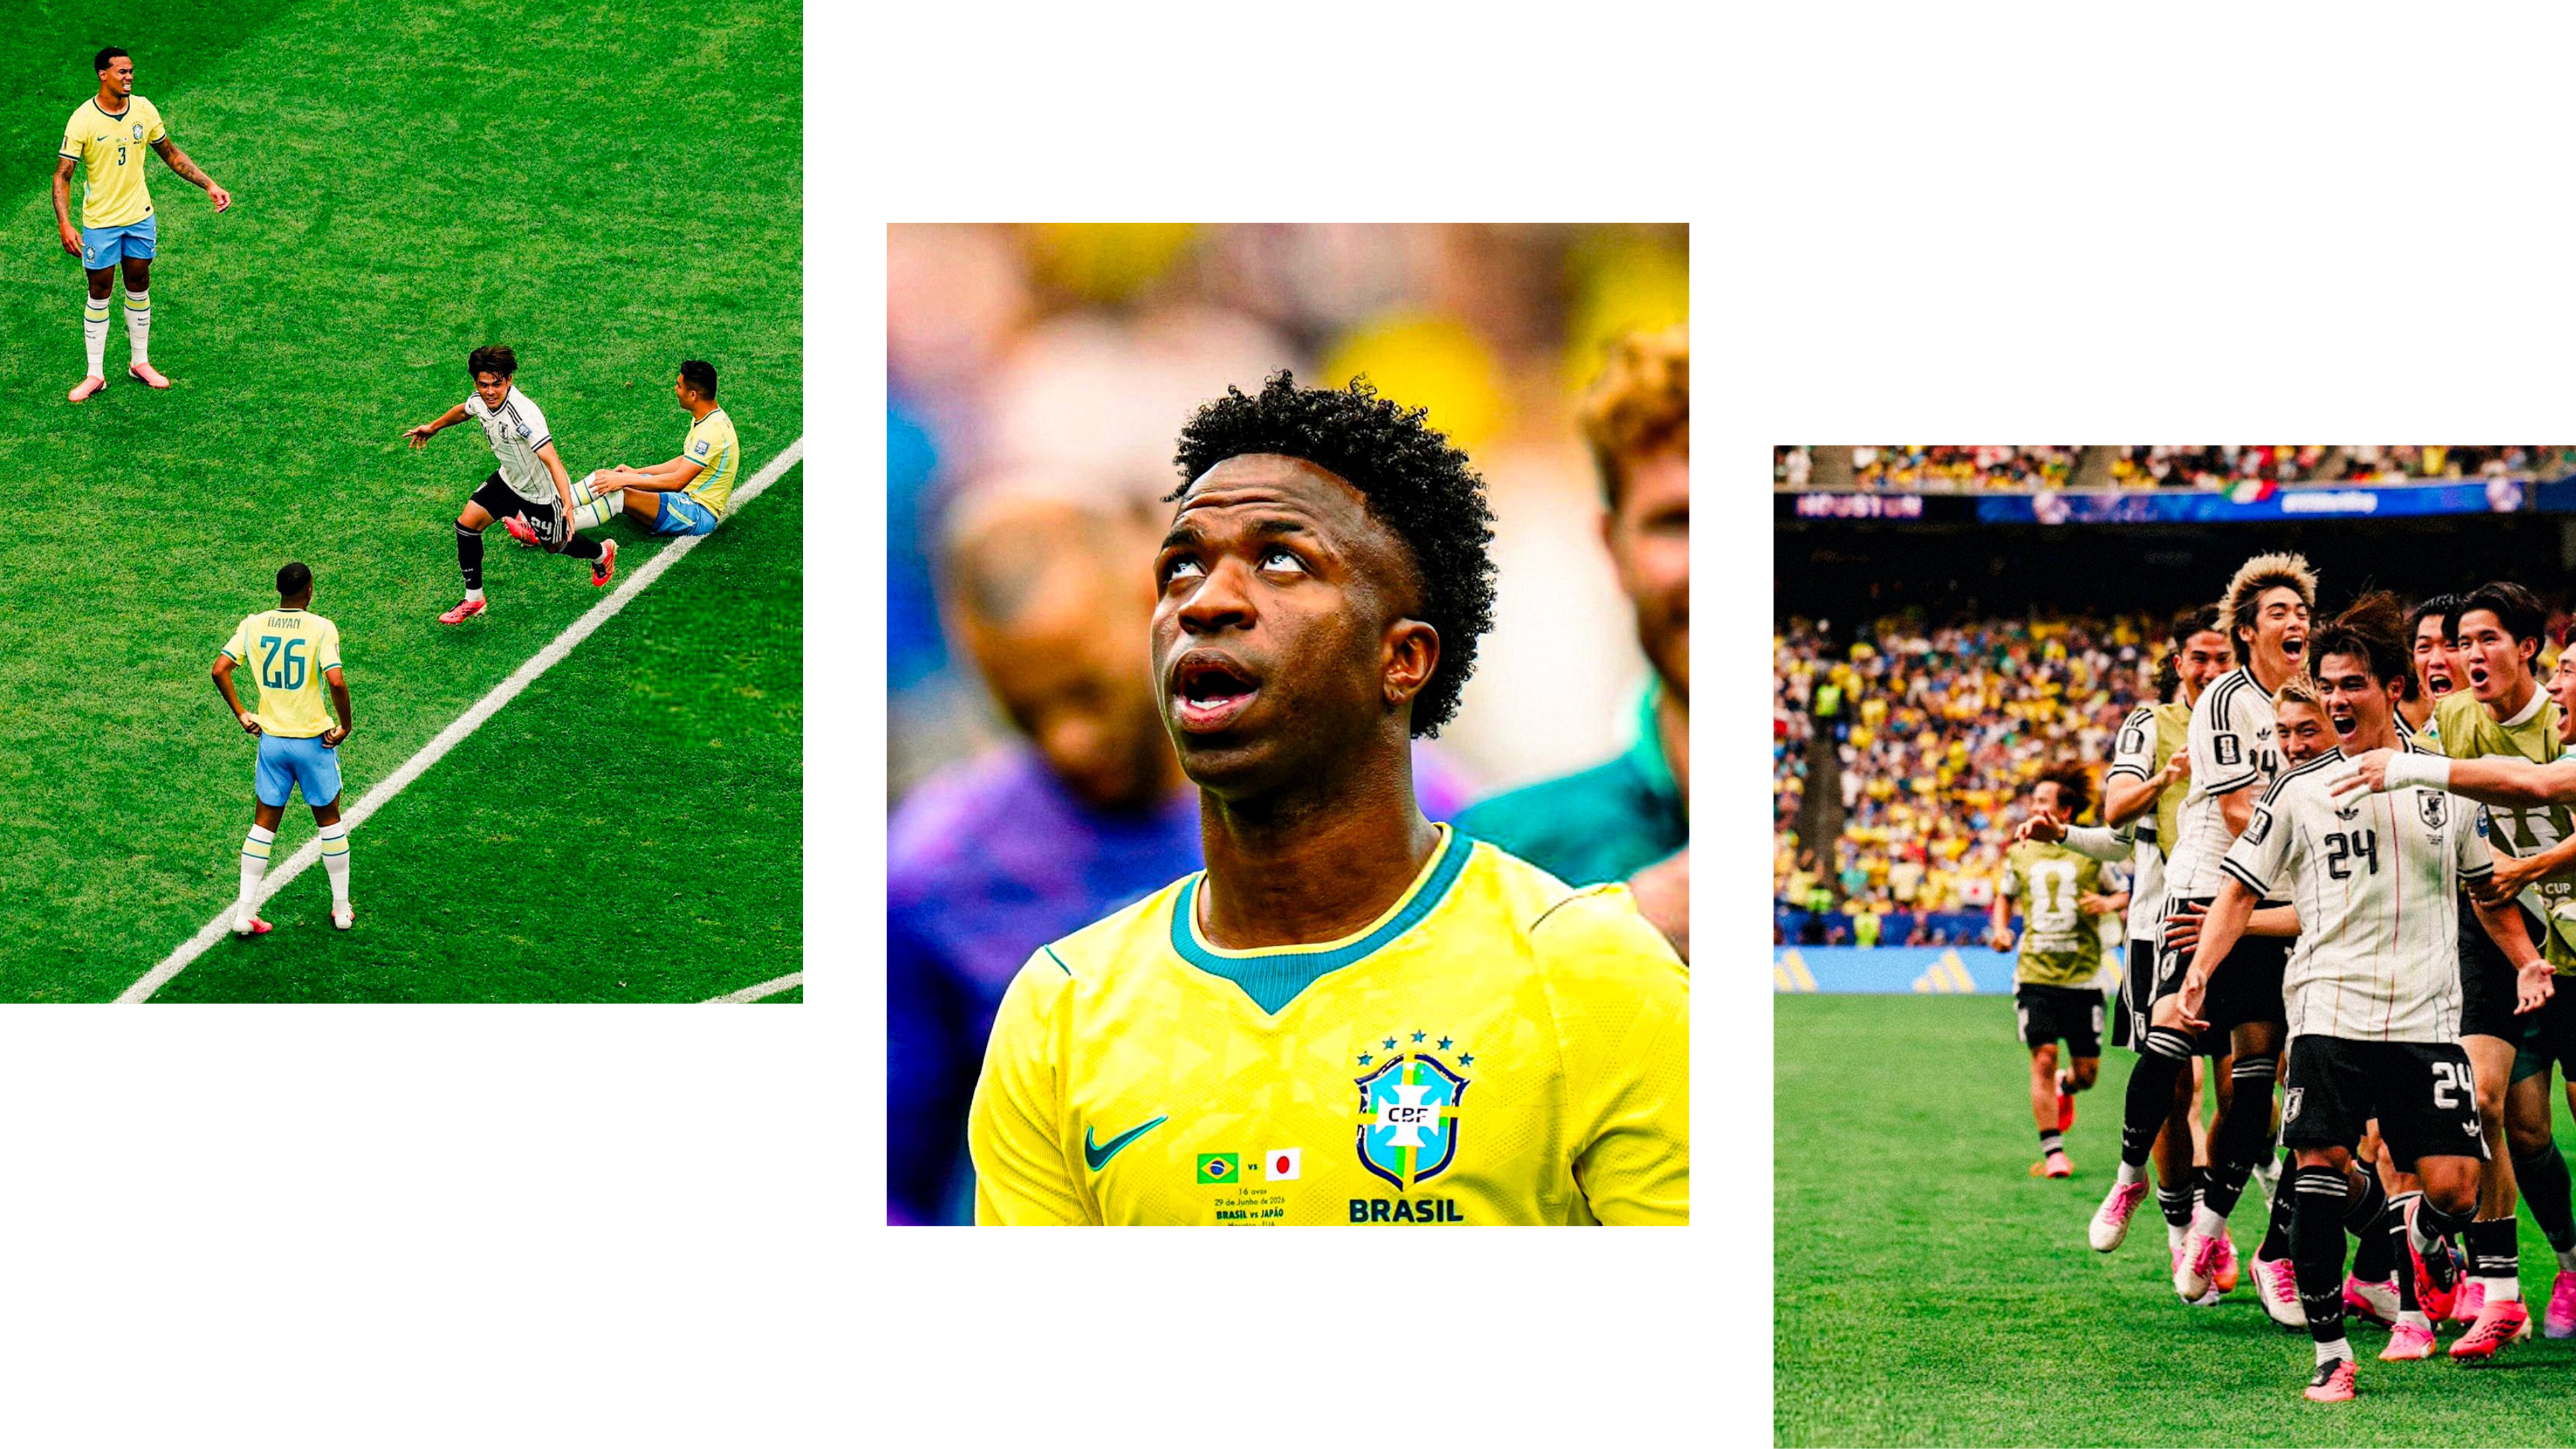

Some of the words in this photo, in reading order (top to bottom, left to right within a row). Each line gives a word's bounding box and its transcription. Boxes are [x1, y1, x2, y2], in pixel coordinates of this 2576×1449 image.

[117, 147, 126, 166] 3
[531, 516, 552, 535] 24
[268, 616, 301, 629] RAYAN
[260, 635, 306, 690] 26
[2324, 828, 2378, 879] 24
[2544, 882, 2571, 895] CUP
[2431, 1062, 2477, 1112] 24
[1388, 1108, 1428, 1123] CBF
[1260, 1207, 1284, 1218] JAPÃO
[1349, 1199, 1464, 1223] BRASIL
